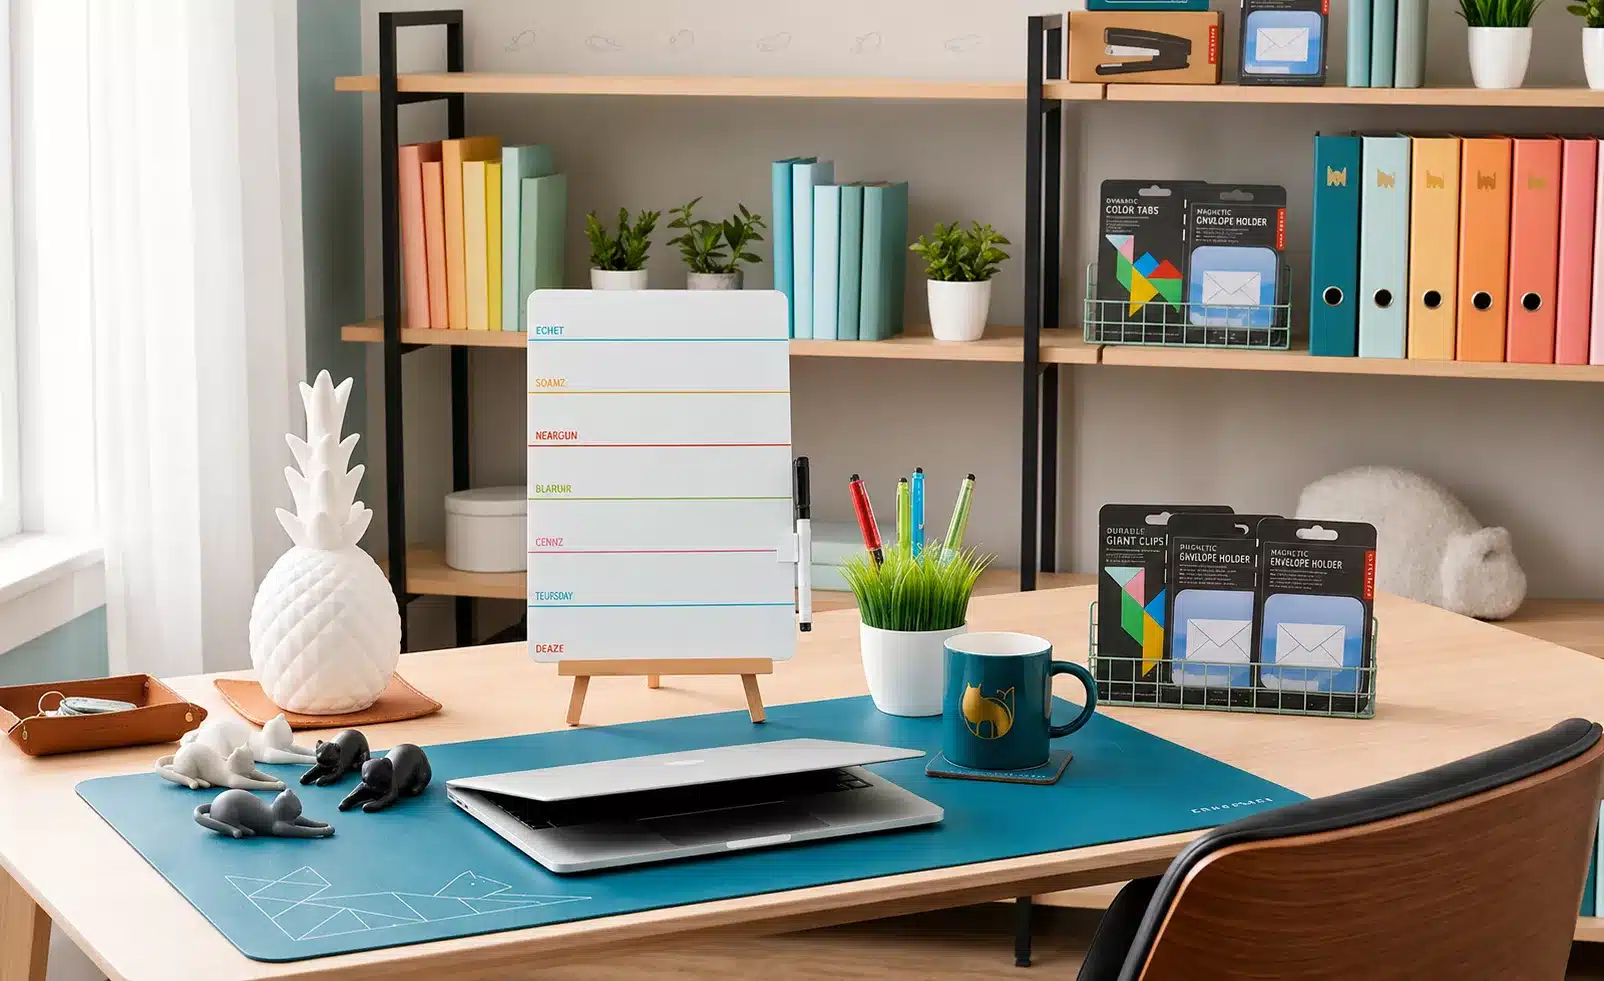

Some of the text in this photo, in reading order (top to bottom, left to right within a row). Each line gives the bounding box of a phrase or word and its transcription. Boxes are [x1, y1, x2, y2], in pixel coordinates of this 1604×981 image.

[1105, 205, 1160, 216] COLOR TABS
[1235, 217, 1268, 227] HOLDER
[535, 326, 565, 335] ECHET
[535, 430, 578, 441] NEARGUN
[535, 537, 564, 547] CENNZ
[1106, 535, 1164, 546] GIANT CLIPS
[1219, 554, 1251, 564] HOLDER
[1311, 559, 1343, 570] HOLDER
[535, 643, 565, 653] DEAZE
